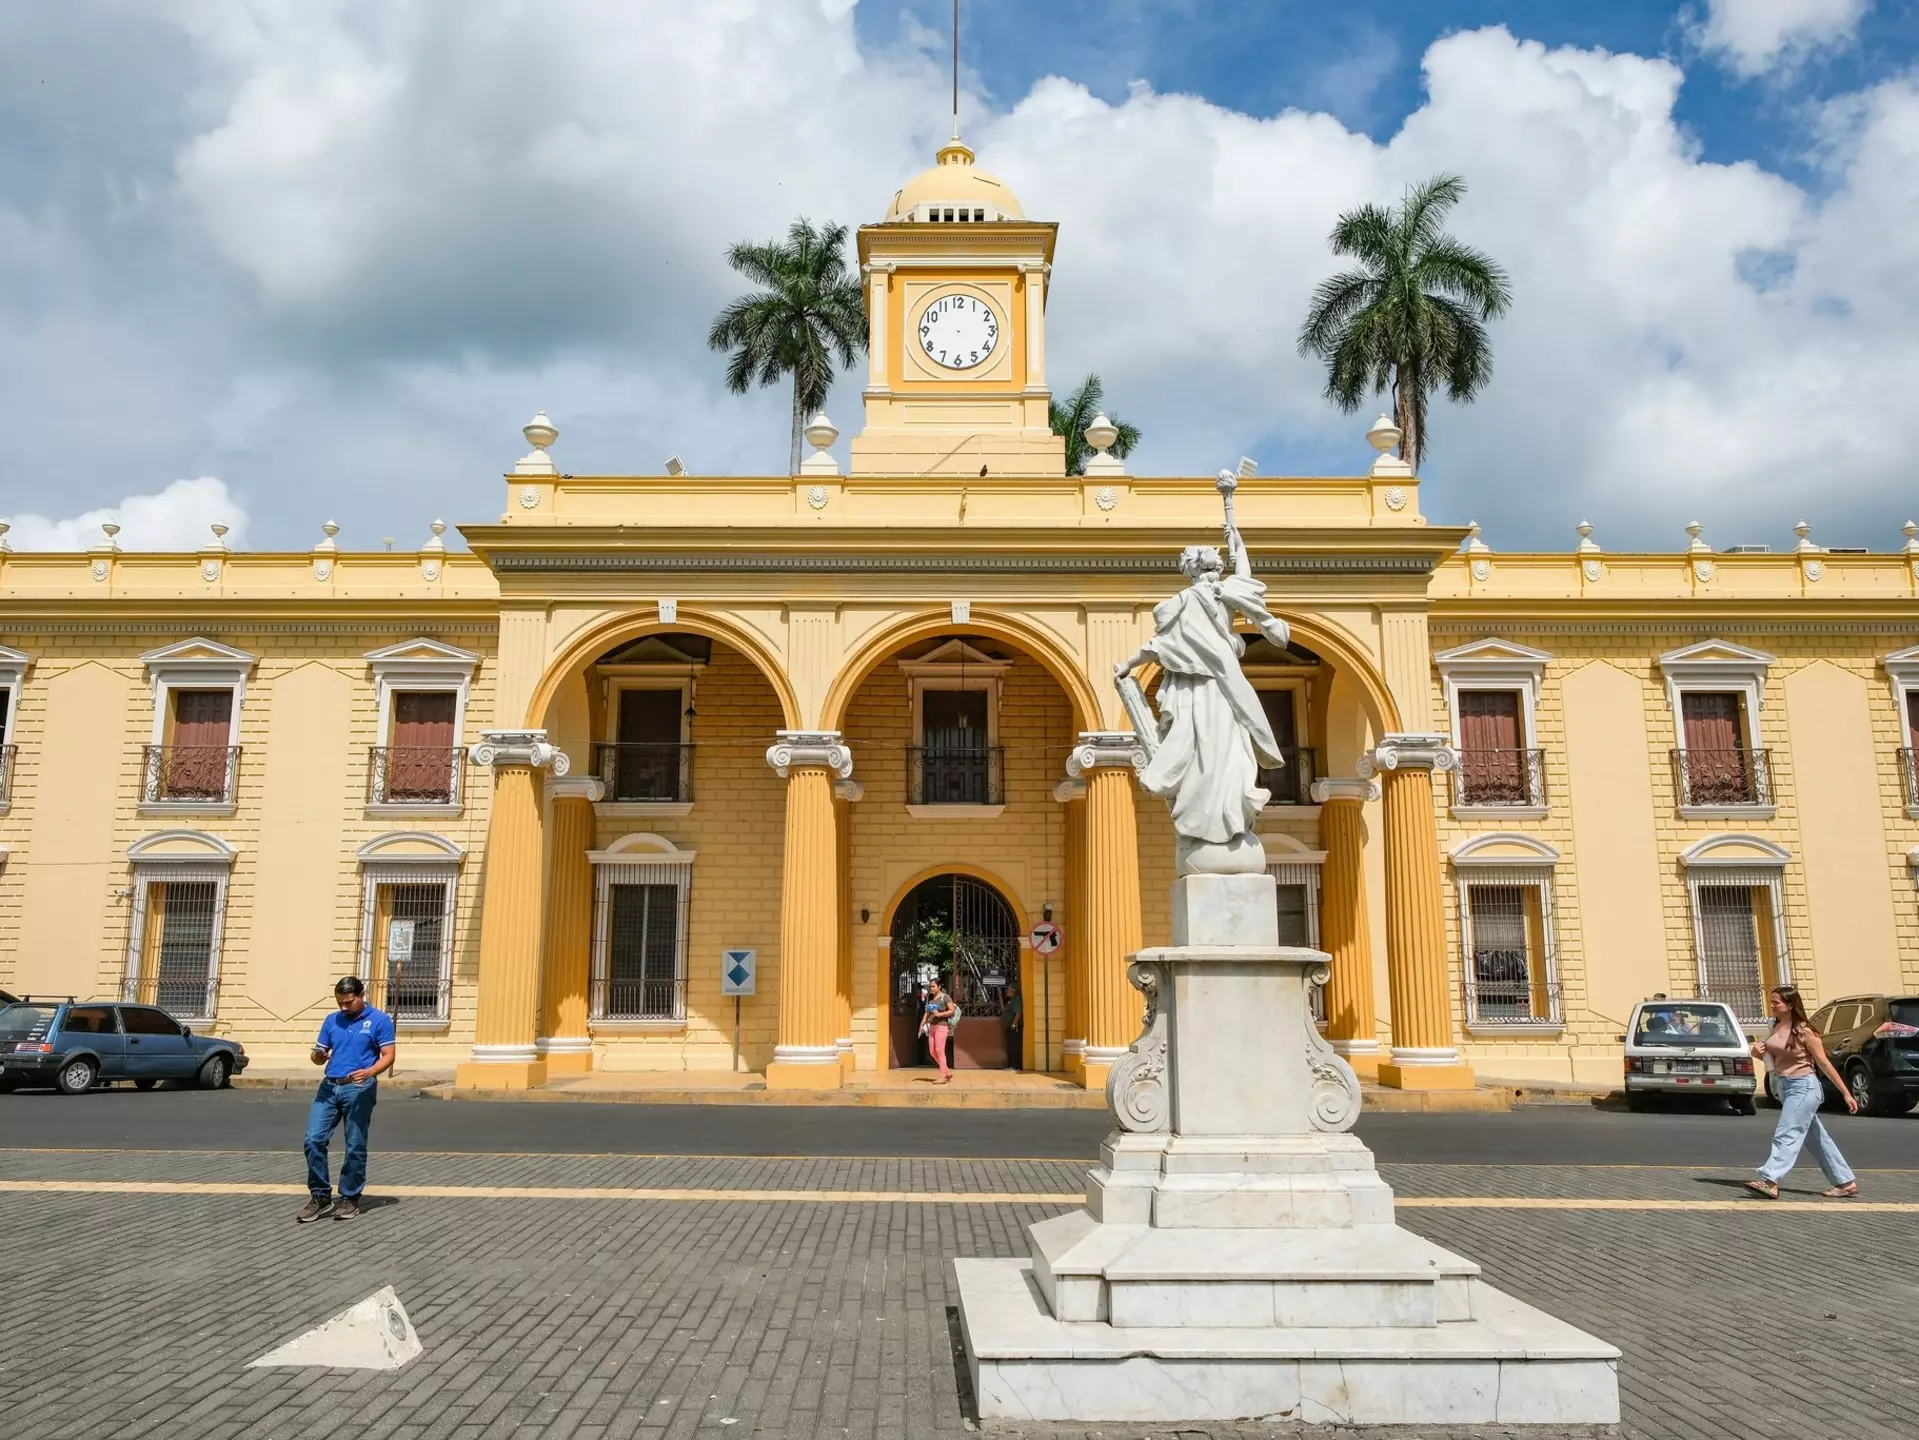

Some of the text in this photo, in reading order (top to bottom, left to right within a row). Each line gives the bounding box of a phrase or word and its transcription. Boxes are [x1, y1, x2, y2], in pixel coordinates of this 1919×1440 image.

[939, 301, 948, 312] 11
[953, 297, 964, 308] 12
[972, 300, 976, 312] 1
[926, 310, 938, 323] 10
[984, 310, 990, 322] 2
[920, 325, 930, 337] 9
[988, 325, 996, 337] 3
[926, 340, 934, 352] 8
[982, 340, 990, 352] 4
[940, 350, 946, 362] 7
[954, 355, 962, 367] 6
[970, 351, 979, 363] 5
